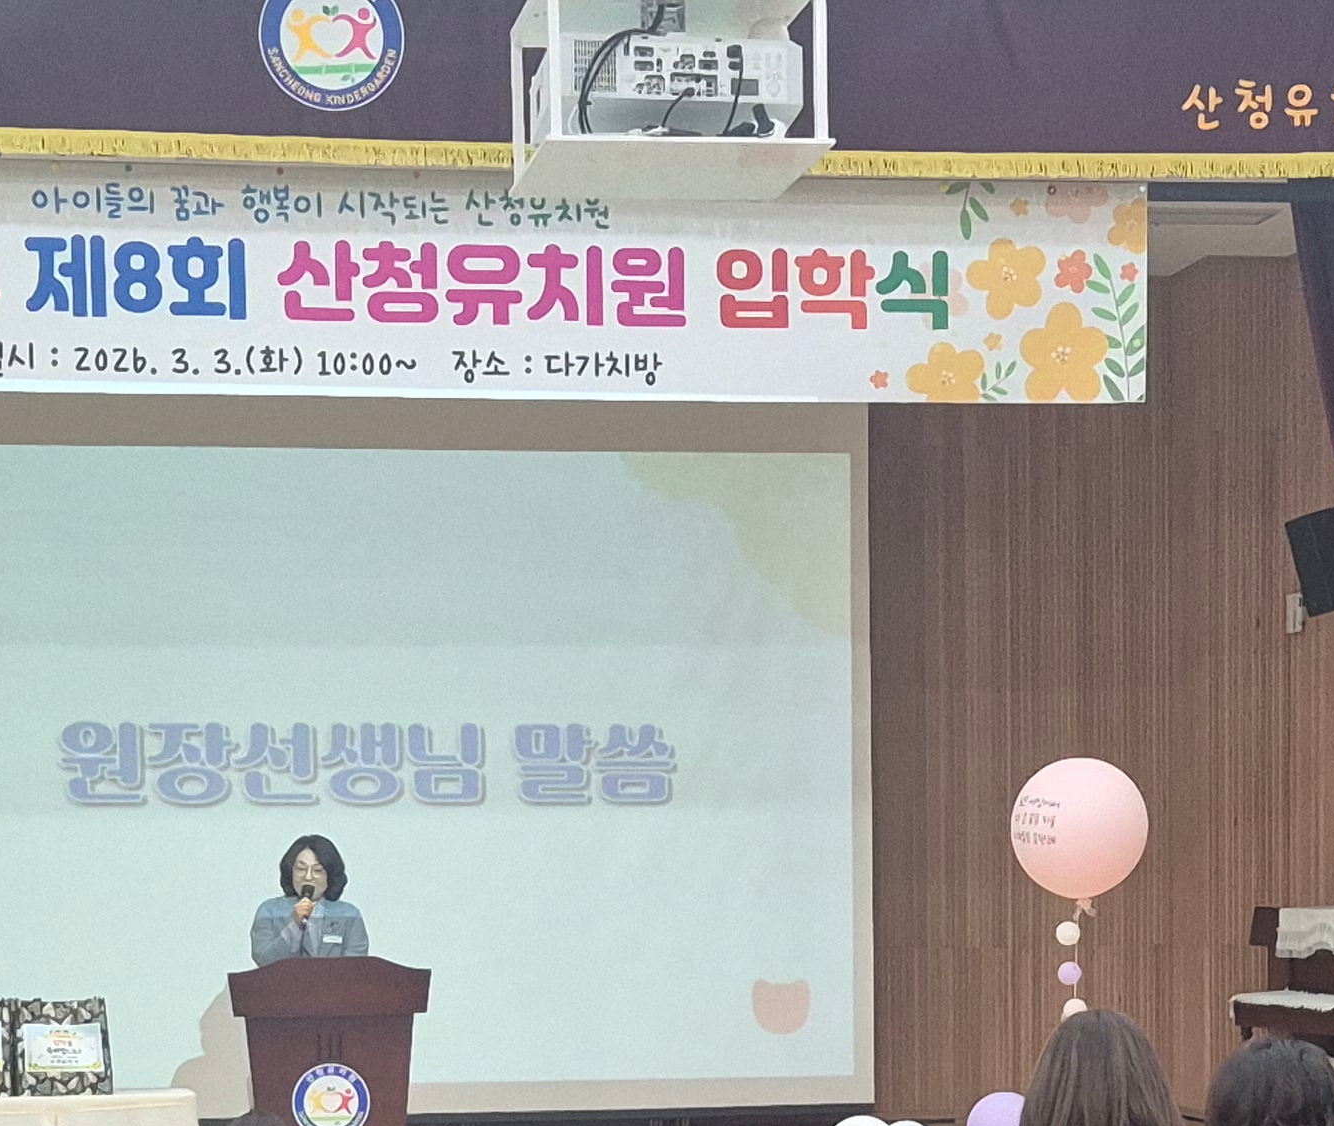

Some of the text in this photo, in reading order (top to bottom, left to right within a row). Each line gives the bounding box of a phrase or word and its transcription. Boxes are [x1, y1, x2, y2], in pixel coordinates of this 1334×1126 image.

[30, 182, 611, 230] 아이들의 꿈과 행복이 시작되는 산청유치원
[23, 233, 248, 321] 제8회
[276, 238, 689, 328] 산청유치원
[715, 248, 950, 330] 입학식
[73, 346, 158, 376] 2026.
[171, 347, 201, 376] 3.
[213, 344, 304, 376] 3.(화)
[317, 350, 417, 377] 10:00~
[451, 349, 511, 384] 장소
[543, 350, 663, 387] 다가치방
[58, 719, 678, 806] 원장선생님 말씀
